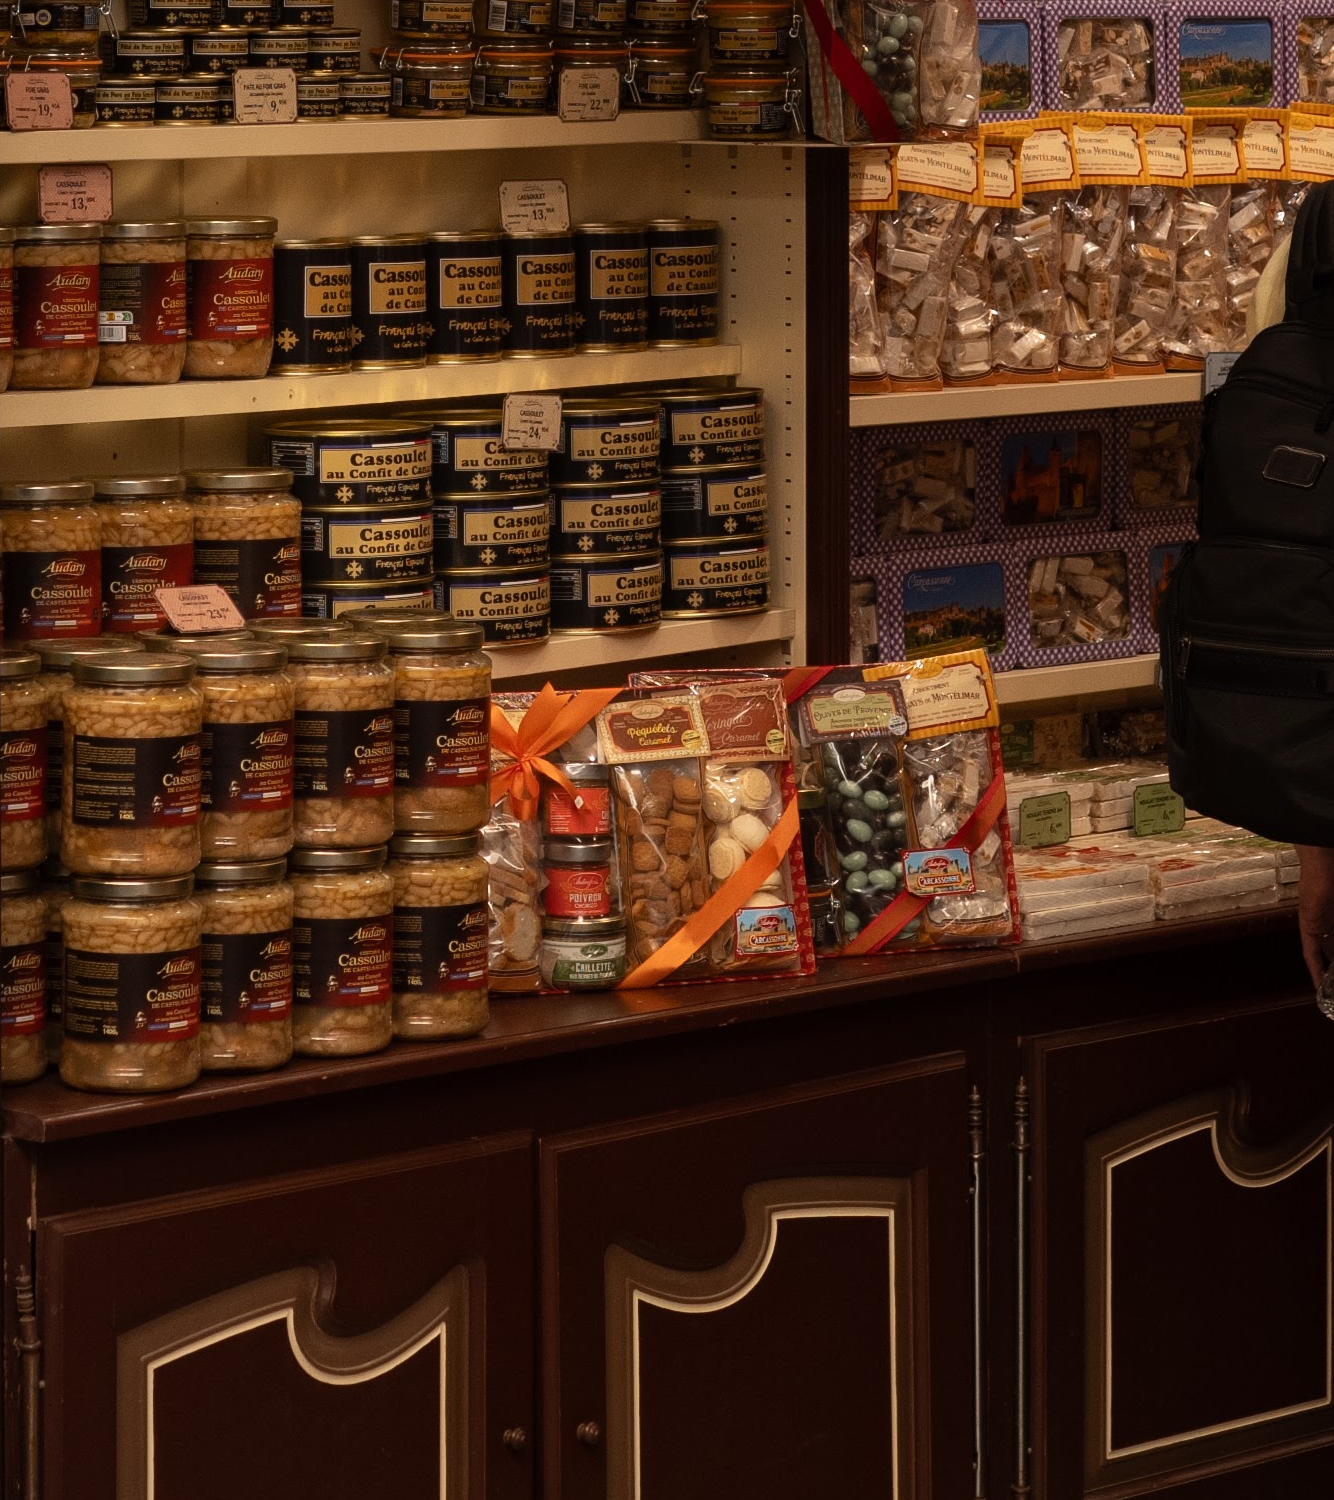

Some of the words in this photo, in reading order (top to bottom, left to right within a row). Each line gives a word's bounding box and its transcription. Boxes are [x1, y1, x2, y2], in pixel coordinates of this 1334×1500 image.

[669, 269, 685, 279] au
[667, 281, 684, 292] de
[214, 294, 271, 306] Cassoulet
[41, 301, 98, 314] Cassoulet
[350, 450, 427, 466] Cassoulet
[327, 470, 345, 479] au
[350, 468, 392, 478] Confit
[396, 467, 409, 476] de
[591, 499, 659, 517] Cassoulet
[568, 521, 585, 529] au
[590, 519, 629, 529] Confit
[632, 518, 644, 527] de
[360, 525, 431, 541] Cassoulet
[336, 545, 354, 554] au
[359, 543, 401, 554] Confit
[404, 542, 417, 551] de
[41, 560, 85, 576] Audary
[119, 555, 167, 570] Audary
[700, 556, 767, 573] Cassoulet
[699, 575, 739, 585] Confit
[31, 586, 93, 599] Cassoulet
[481, 586, 548, 603] Cassoulet
[479, 606, 519, 616] Confit
[522, 605, 533, 614] de
[639, 735, 672, 746] Caramel
[568, 892, 602, 903] POIVRON
